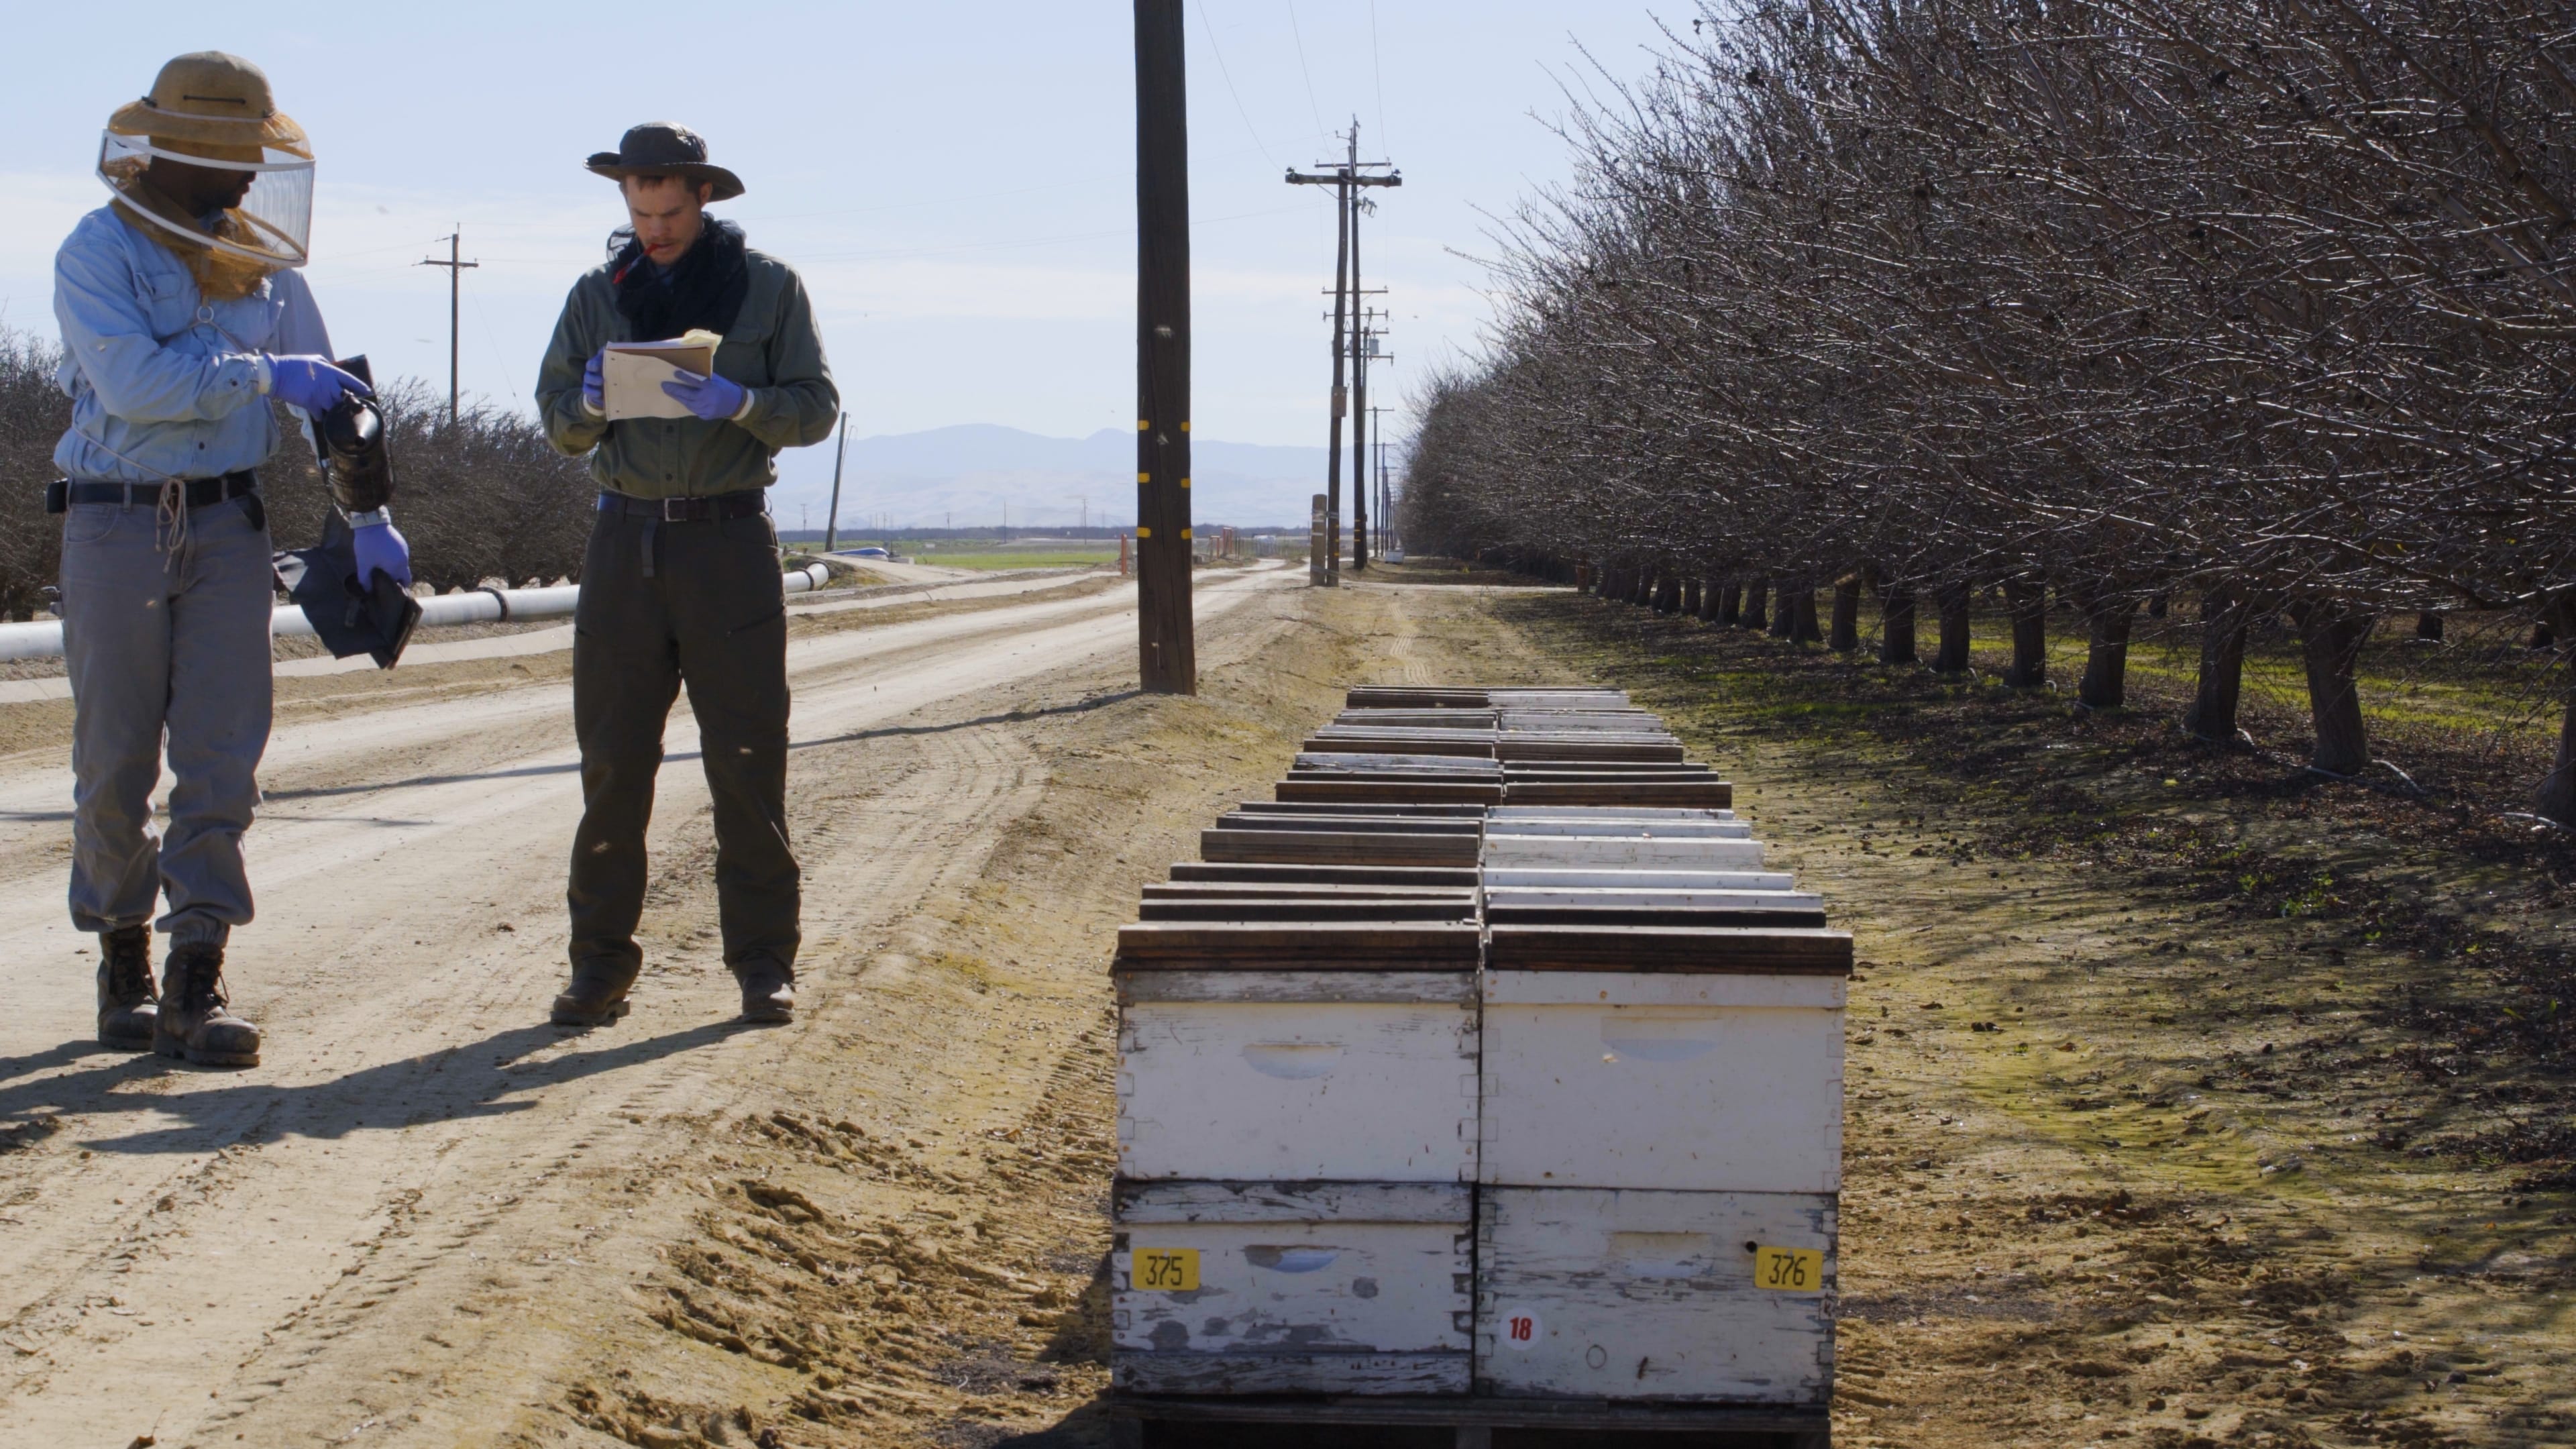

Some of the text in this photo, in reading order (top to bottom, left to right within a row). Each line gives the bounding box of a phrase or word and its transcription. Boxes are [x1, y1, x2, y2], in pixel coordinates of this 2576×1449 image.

[1146, 1255, 1183, 1285] 375
[1769, 1254, 1807, 1286] 376
[1509, 1316, 1532, 1341] 18
